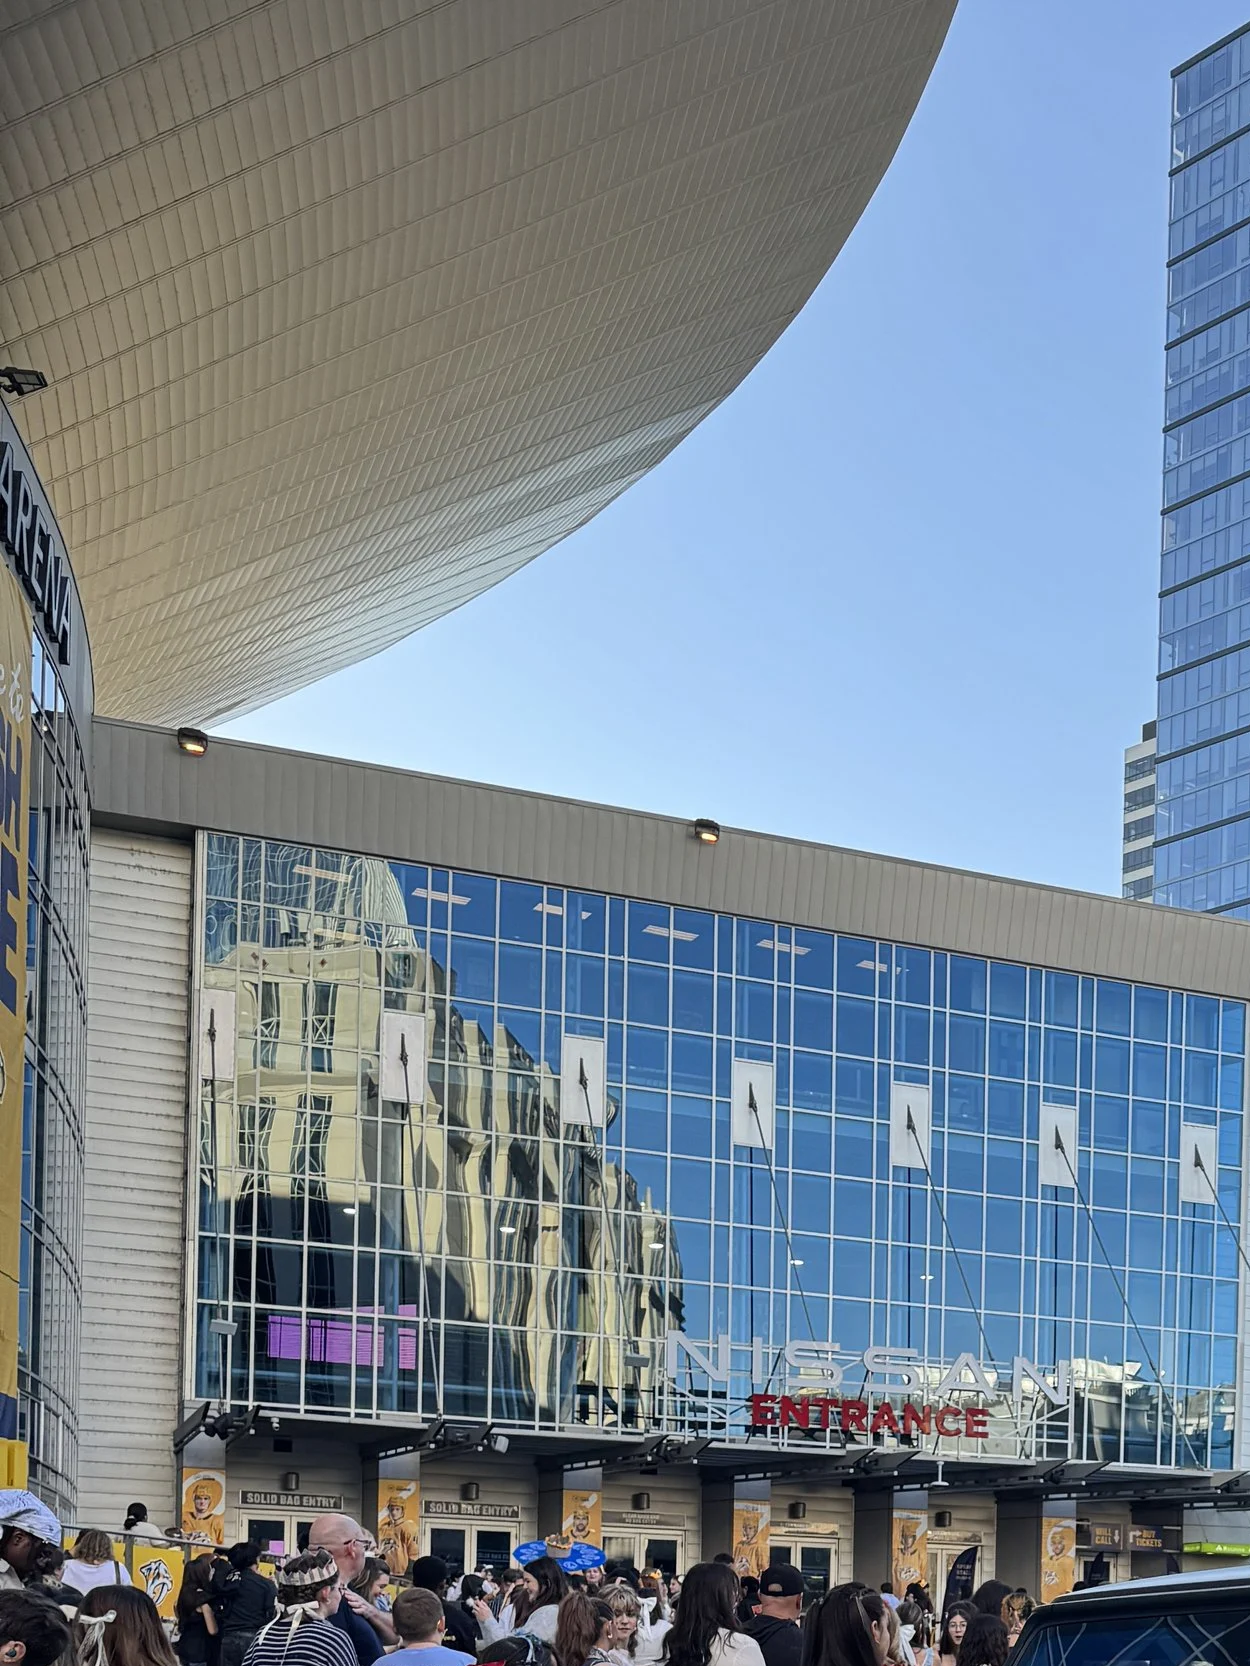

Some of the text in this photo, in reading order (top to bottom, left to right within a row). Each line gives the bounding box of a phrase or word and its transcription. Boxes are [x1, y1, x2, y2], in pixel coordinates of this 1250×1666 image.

[0, 442, 71, 665] ARENA
[666, 1329, 1070, 1406] NISSAN
[752, 1394, 989, 1439] ENTRANCE
[246, 1493, 336, 1507] SOLID BAG ENTRY
[429, 1502, 513, 1517] SOLID BAG ENTRY
[1095, 1536, 1112, 1545] CALL
[1136, 1538, 1162, 1547] TICKETS
